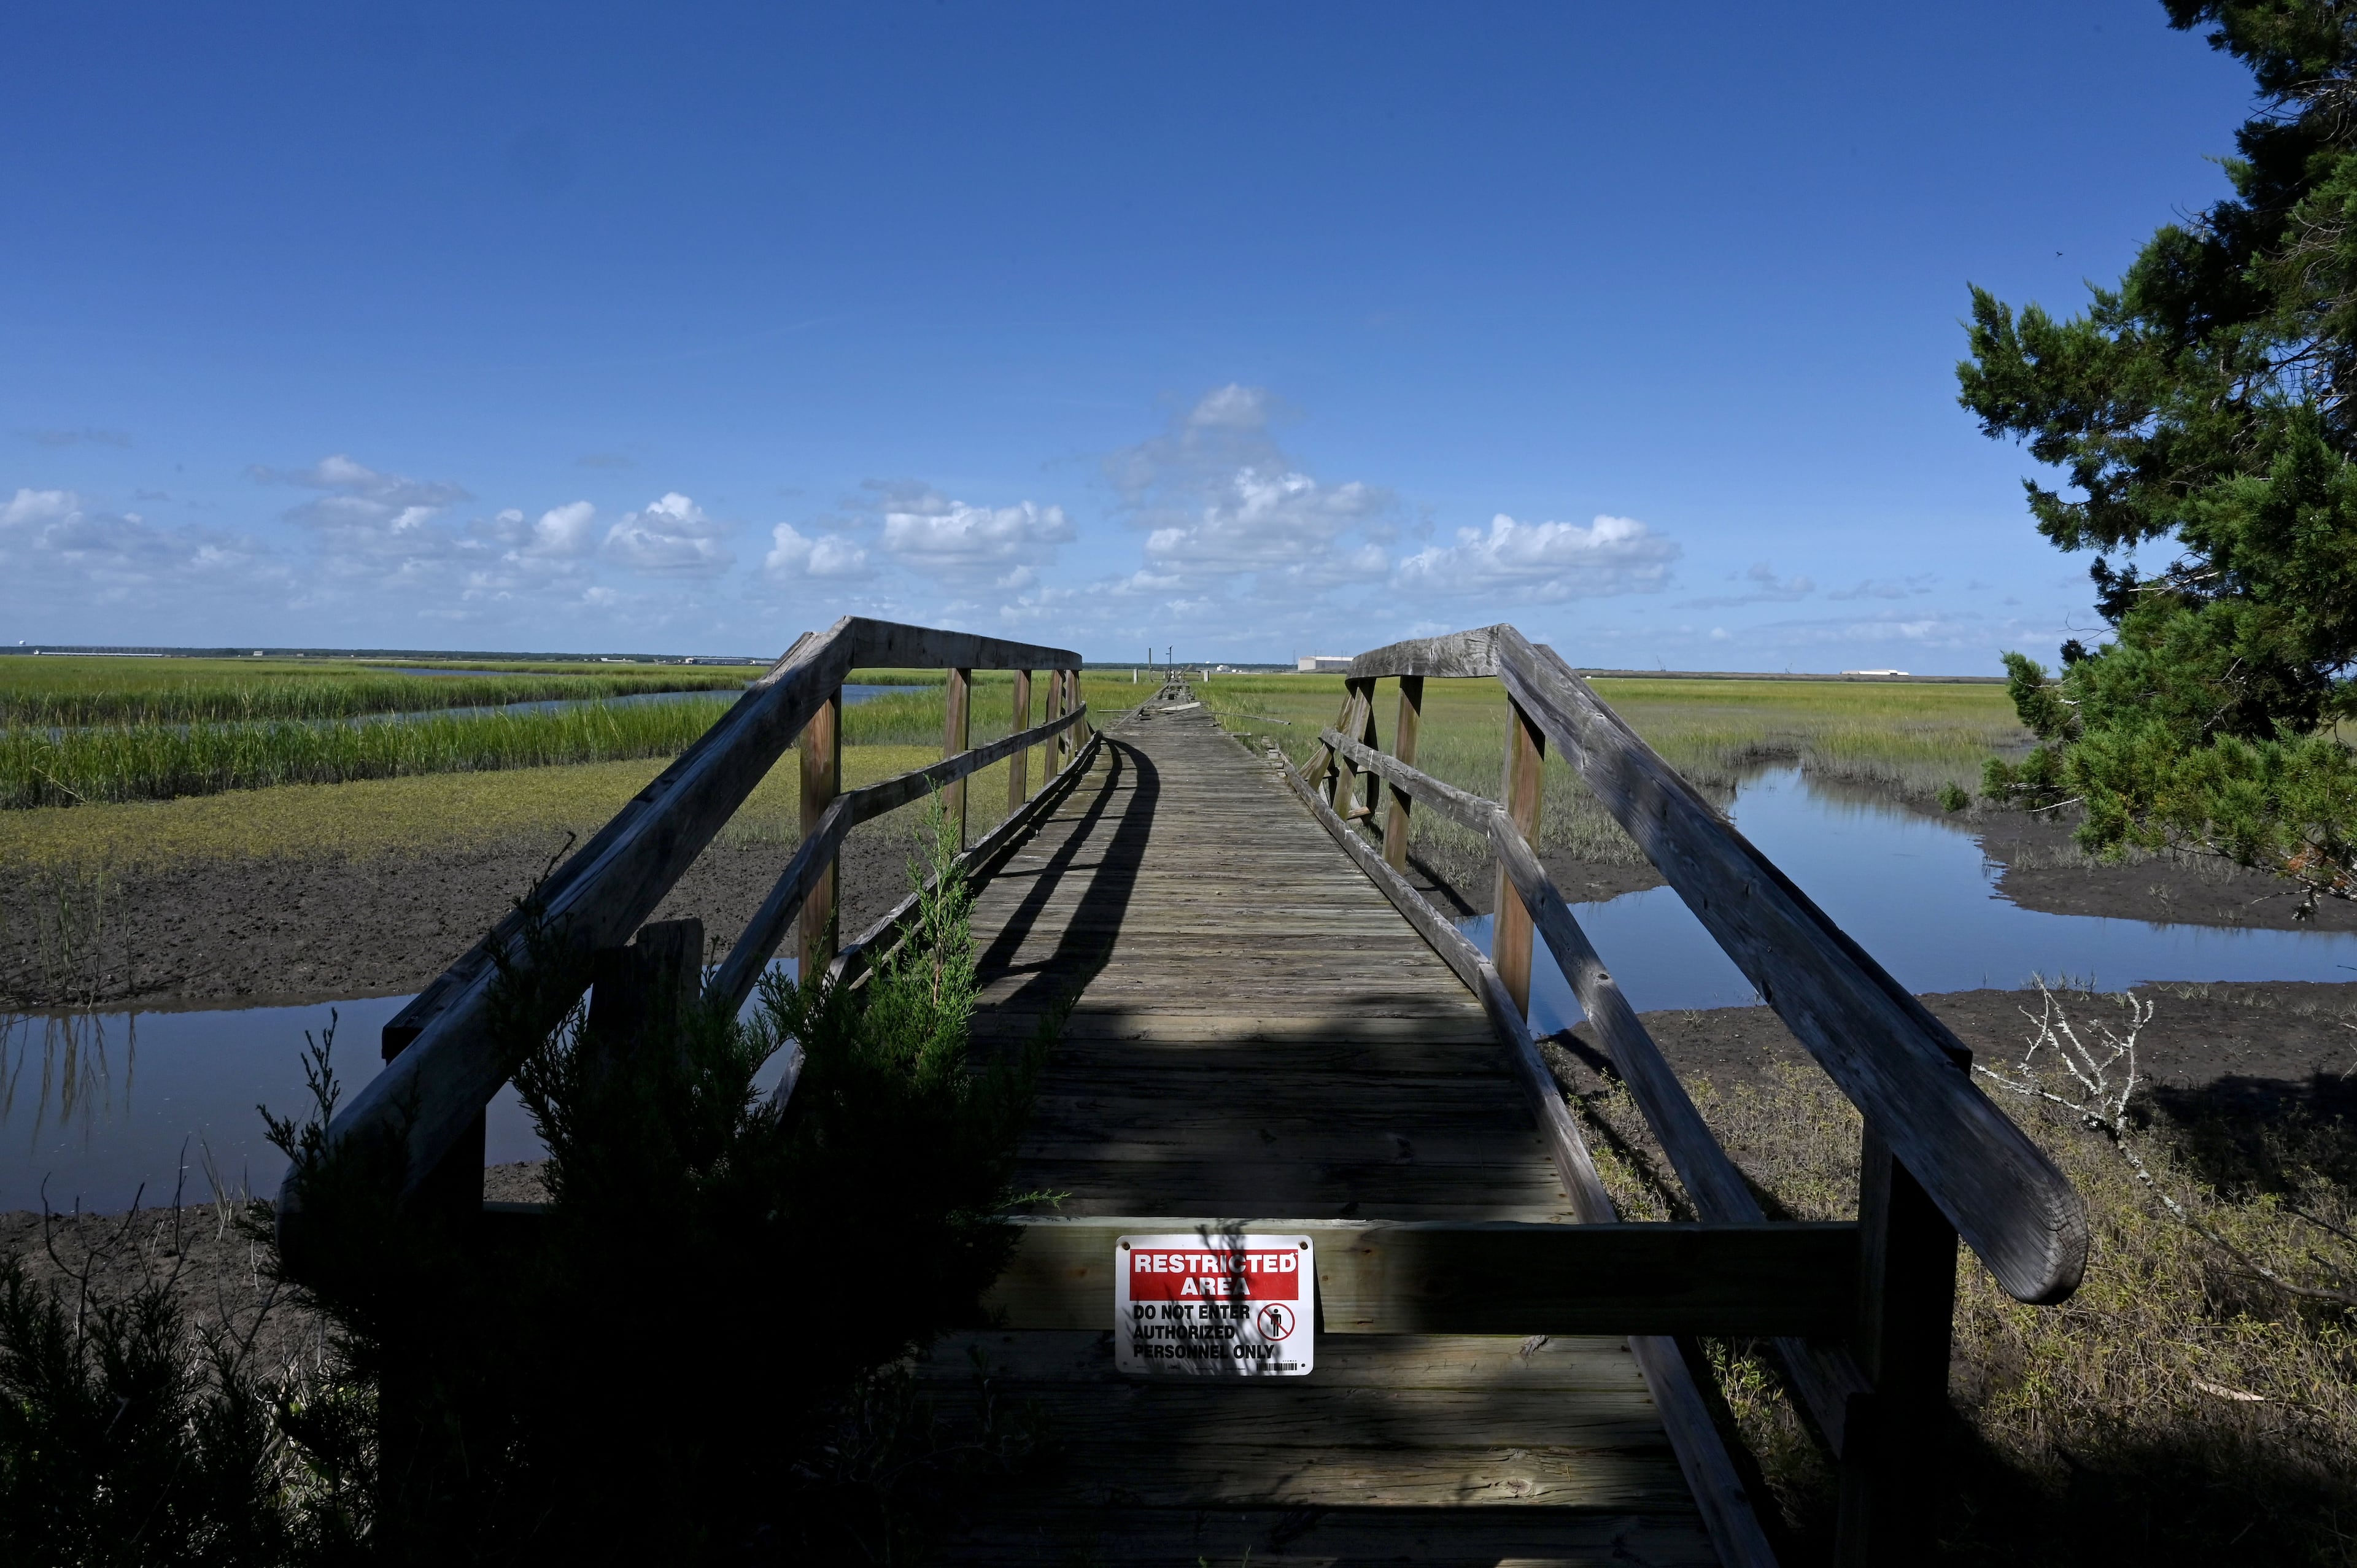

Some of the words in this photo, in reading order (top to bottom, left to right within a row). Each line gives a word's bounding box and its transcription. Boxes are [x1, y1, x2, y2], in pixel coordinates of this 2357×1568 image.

[1135, 1254, 1296, 1273] RESTRICTED
[1180, 1277, 1250, 1295] AREA
[1134, 1305, 1156, 1319] DO
[1161, 1305, 1193, 1319] NOT
[1199, 1305, 1250, 1319] ENTER
[1133, 1325, 1235, 1339] AUTHORIZED
[1134, 1345, 1229, 1359] PERSONNEL
[1233, 1345, 1275, 1359] ONLY
